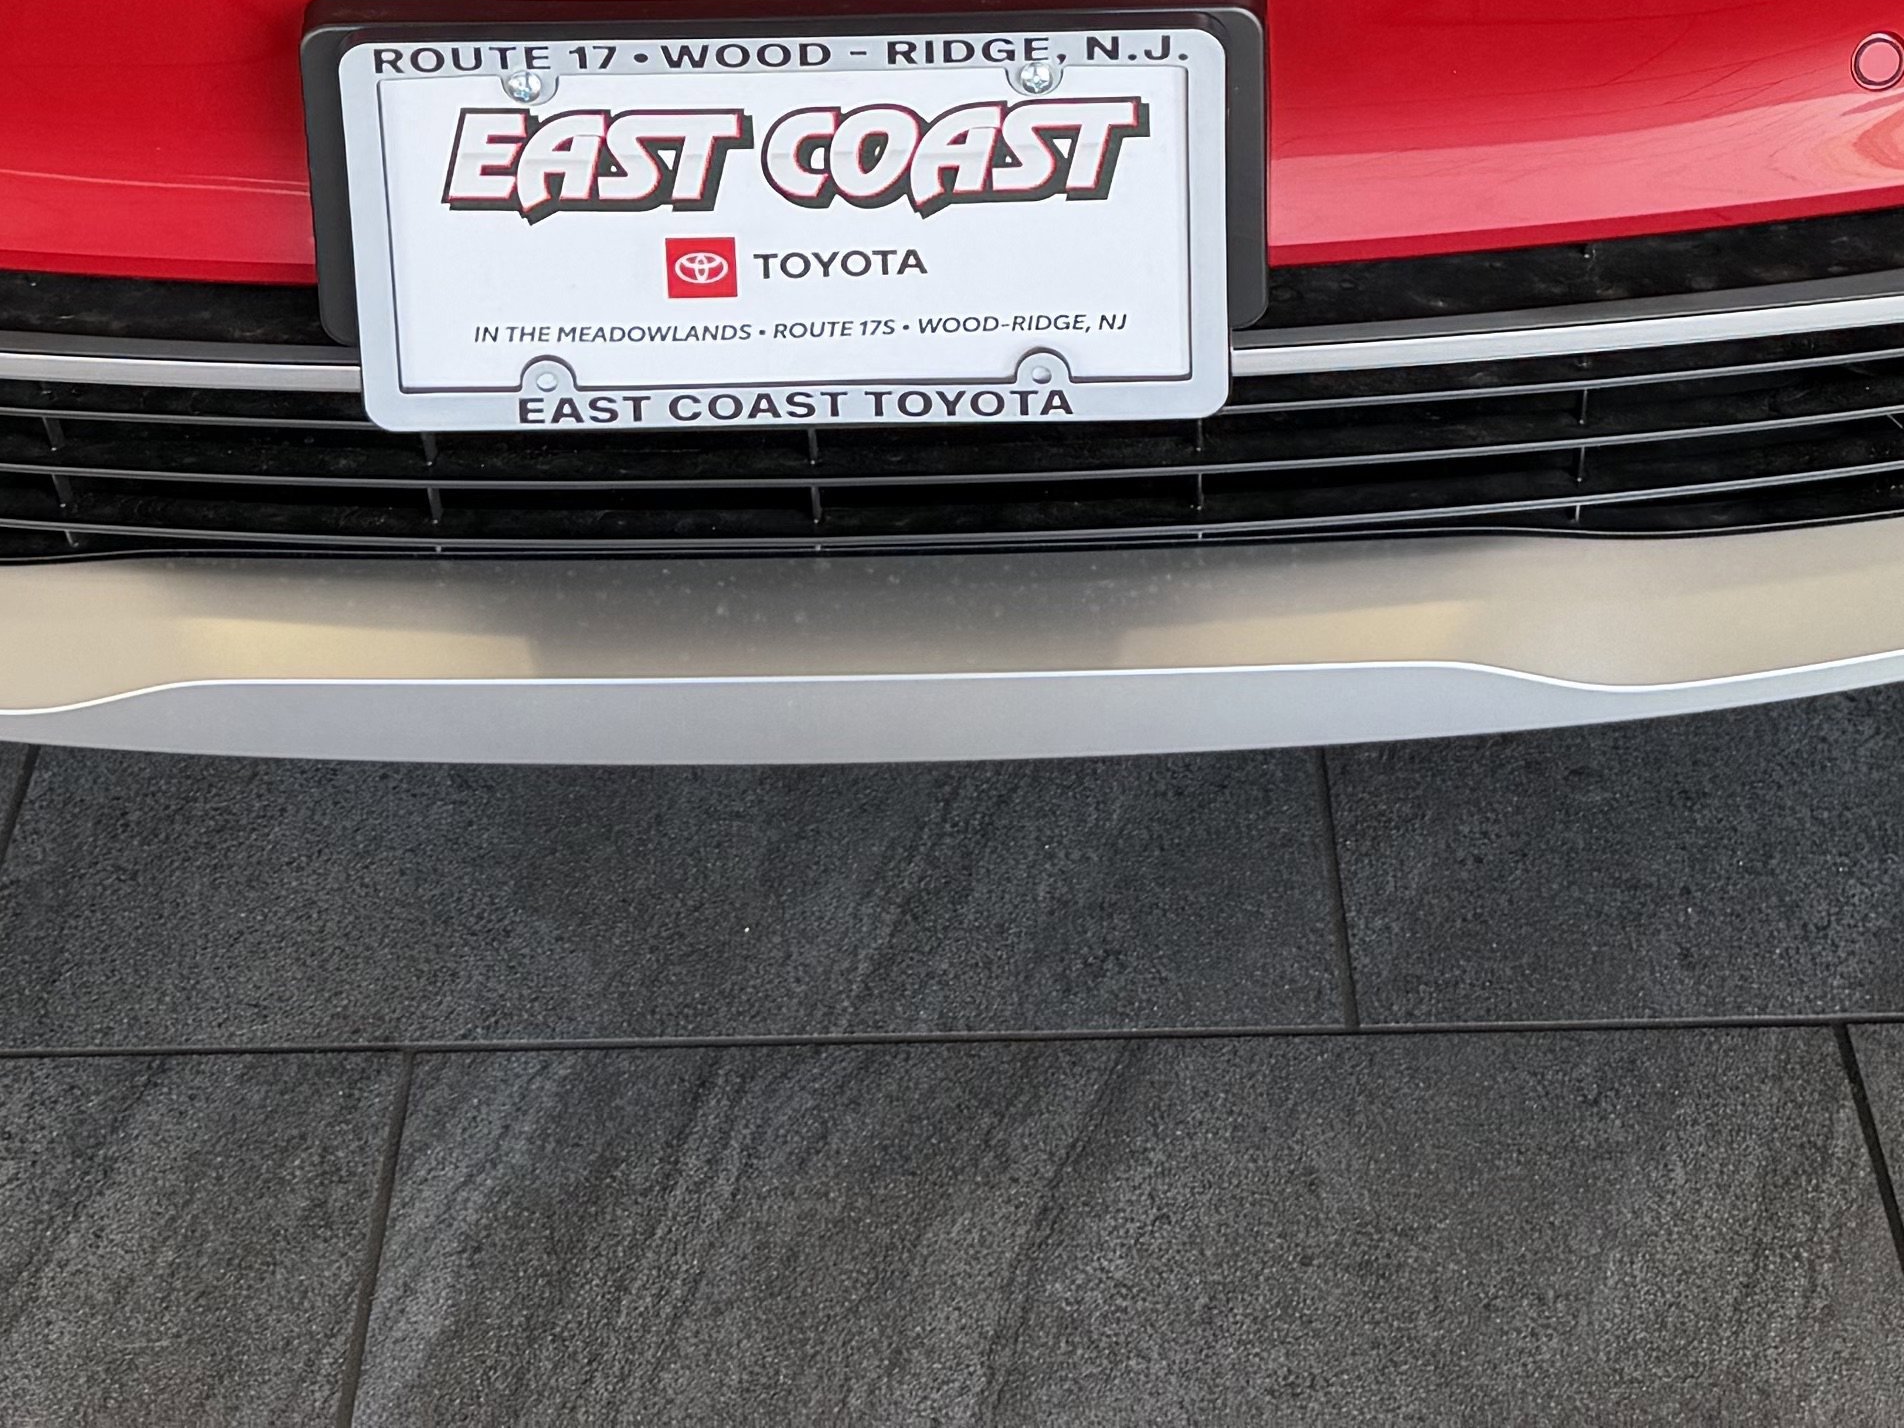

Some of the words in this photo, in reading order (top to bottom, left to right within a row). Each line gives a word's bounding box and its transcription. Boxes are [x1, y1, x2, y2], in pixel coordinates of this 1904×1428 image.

[374, 46, 551, 73] ROUTE
[569, 45, 618, 70] 17
[661, 43, 831, 69] WOOD
[888, 37, 1066, 65] RIDGE,
[1087, 35, 1189, 61] N.J.
[441, 107, 754, 226] EAST
[761, 96, 1150, 219] COAST
[753, 249, 928, 279] TOYOTA
[474, 326, 499, 343] IN
[506, 325, 550, 342] THE
[557, 323, 752, 343] MEADOWLANDS
[773, 320, 854, 339] ROUTE
[859, 319, 895, 337] 17S
[918, 314, 1092, 334] WOOD-RIDGE,
[1098, 313, 1127, 331] NJ
[518, 395, 651, 425] EAST
[668, 391, 848, 421] COAST
[864, 390, 1074, 417] TOYOTA
